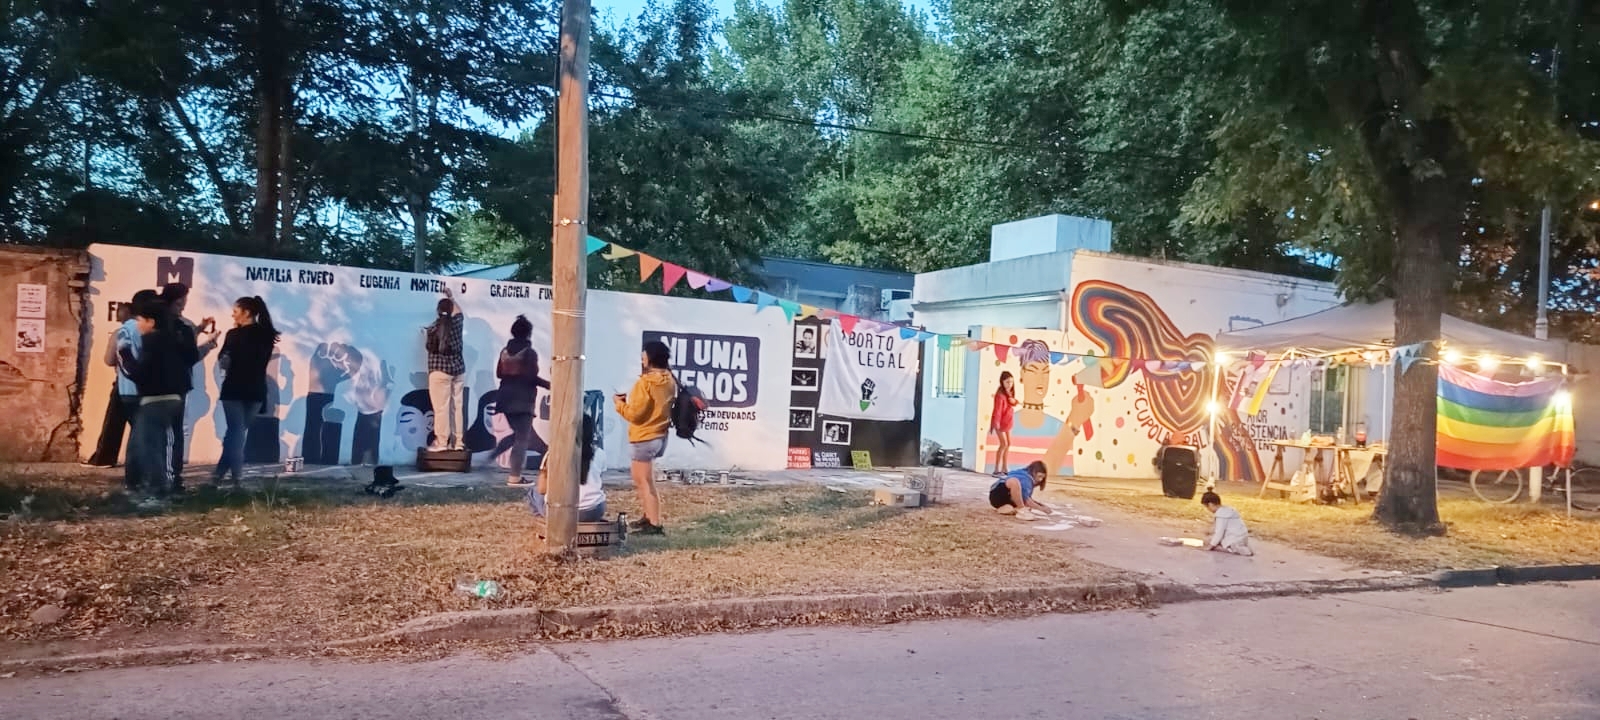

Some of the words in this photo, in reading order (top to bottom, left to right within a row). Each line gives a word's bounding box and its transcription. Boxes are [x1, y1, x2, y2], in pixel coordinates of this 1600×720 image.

[246, 267, 292, 283] NATALIA
[299, 269, 334, 285] RIVERO
[360, 274, 400, 290] EUGENIA
[490, 284, 530, 299] GRACIELA
[661, 336, 688, 367] NI
[694, 339, 748, 370] UNA
[858, 350, 905, 369] LEGAL
[671, 369, 748, 403] ENOS
